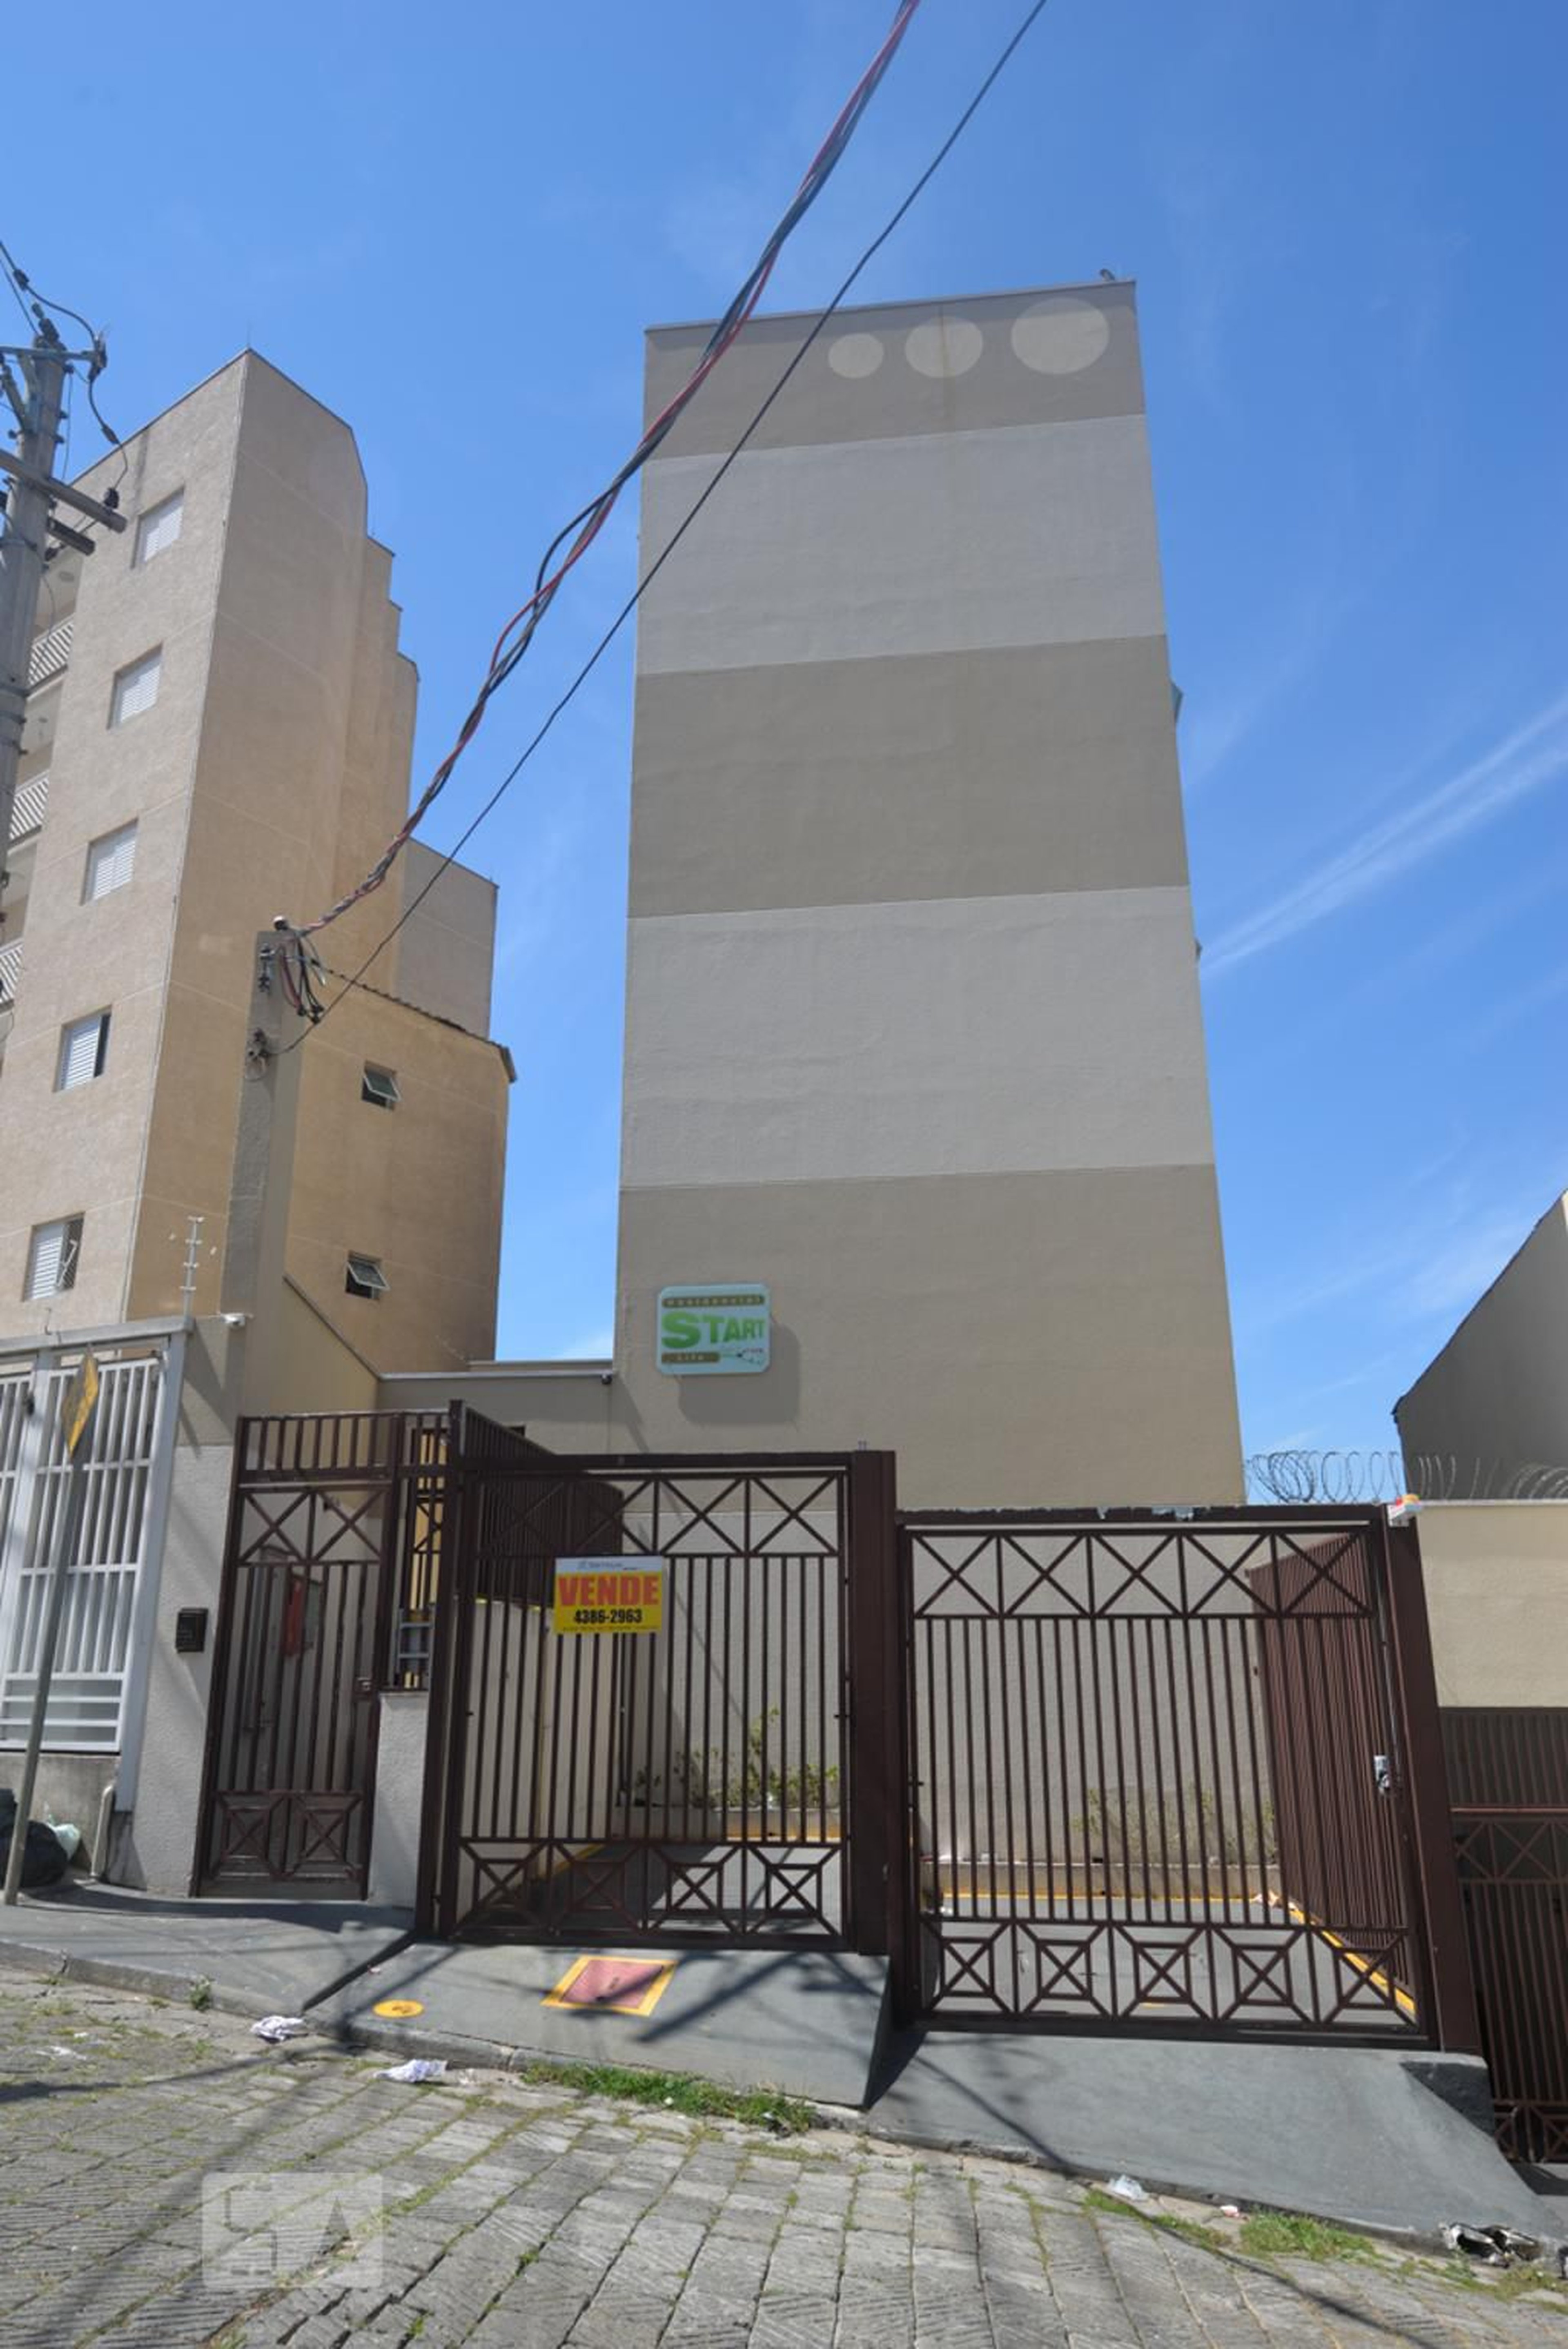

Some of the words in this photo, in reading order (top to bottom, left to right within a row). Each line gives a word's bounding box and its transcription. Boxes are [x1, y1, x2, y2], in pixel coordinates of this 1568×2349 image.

[662, 1311, 765, 1349] START
[559, 1575, 658, 1606] VENDE
[575, 1609, 642, 1624] 4386-2963
